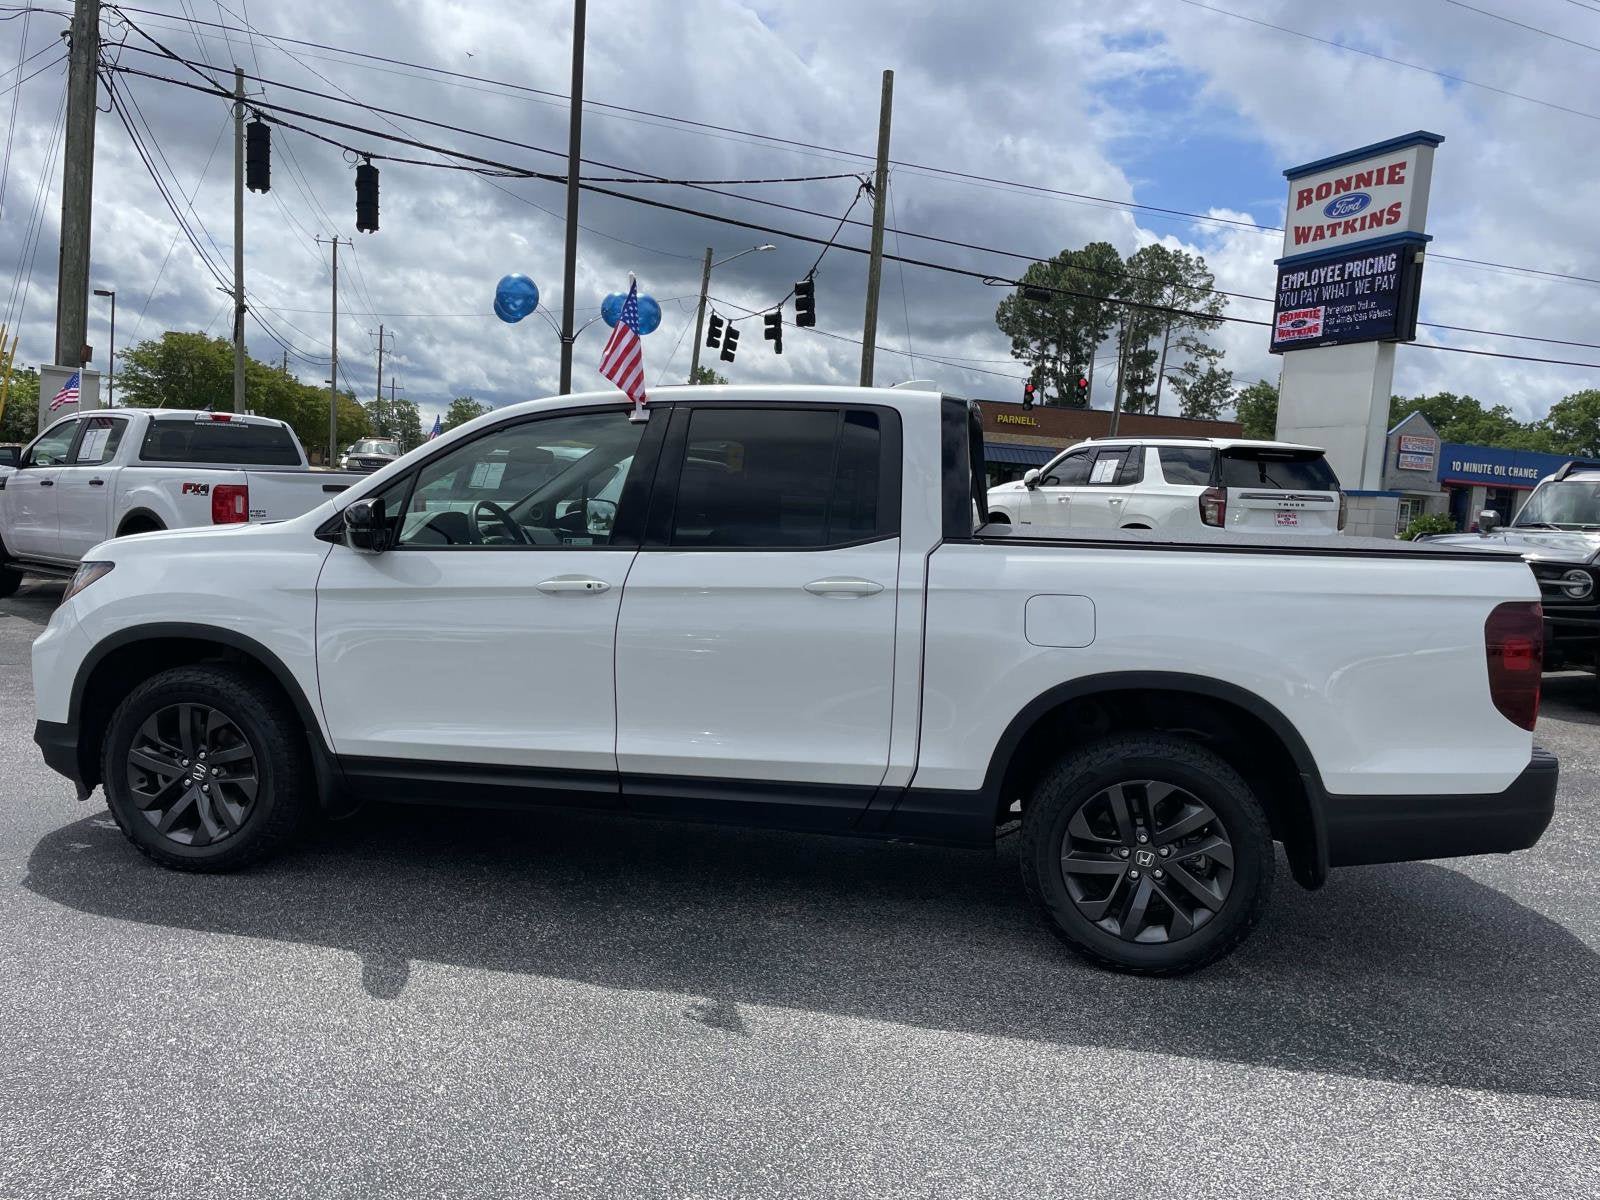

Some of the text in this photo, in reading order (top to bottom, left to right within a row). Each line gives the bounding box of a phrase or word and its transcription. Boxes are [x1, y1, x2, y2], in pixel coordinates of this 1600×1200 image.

[1296, 161, 1407, 210] RONNIE
[1294, 202, 1402, 245] WATKINS
[1332, 199, 1363, 215] Ford
[1281, 253, 1397, 290] EMPLOYEE PRICING
[1279, 273, 1397, 308] YOU PAY WHAT WE PAY
[1452, 461, 1539, 479] 10 MINUTE OIL CHANGE
[182, 482, 209, 494] FX4
